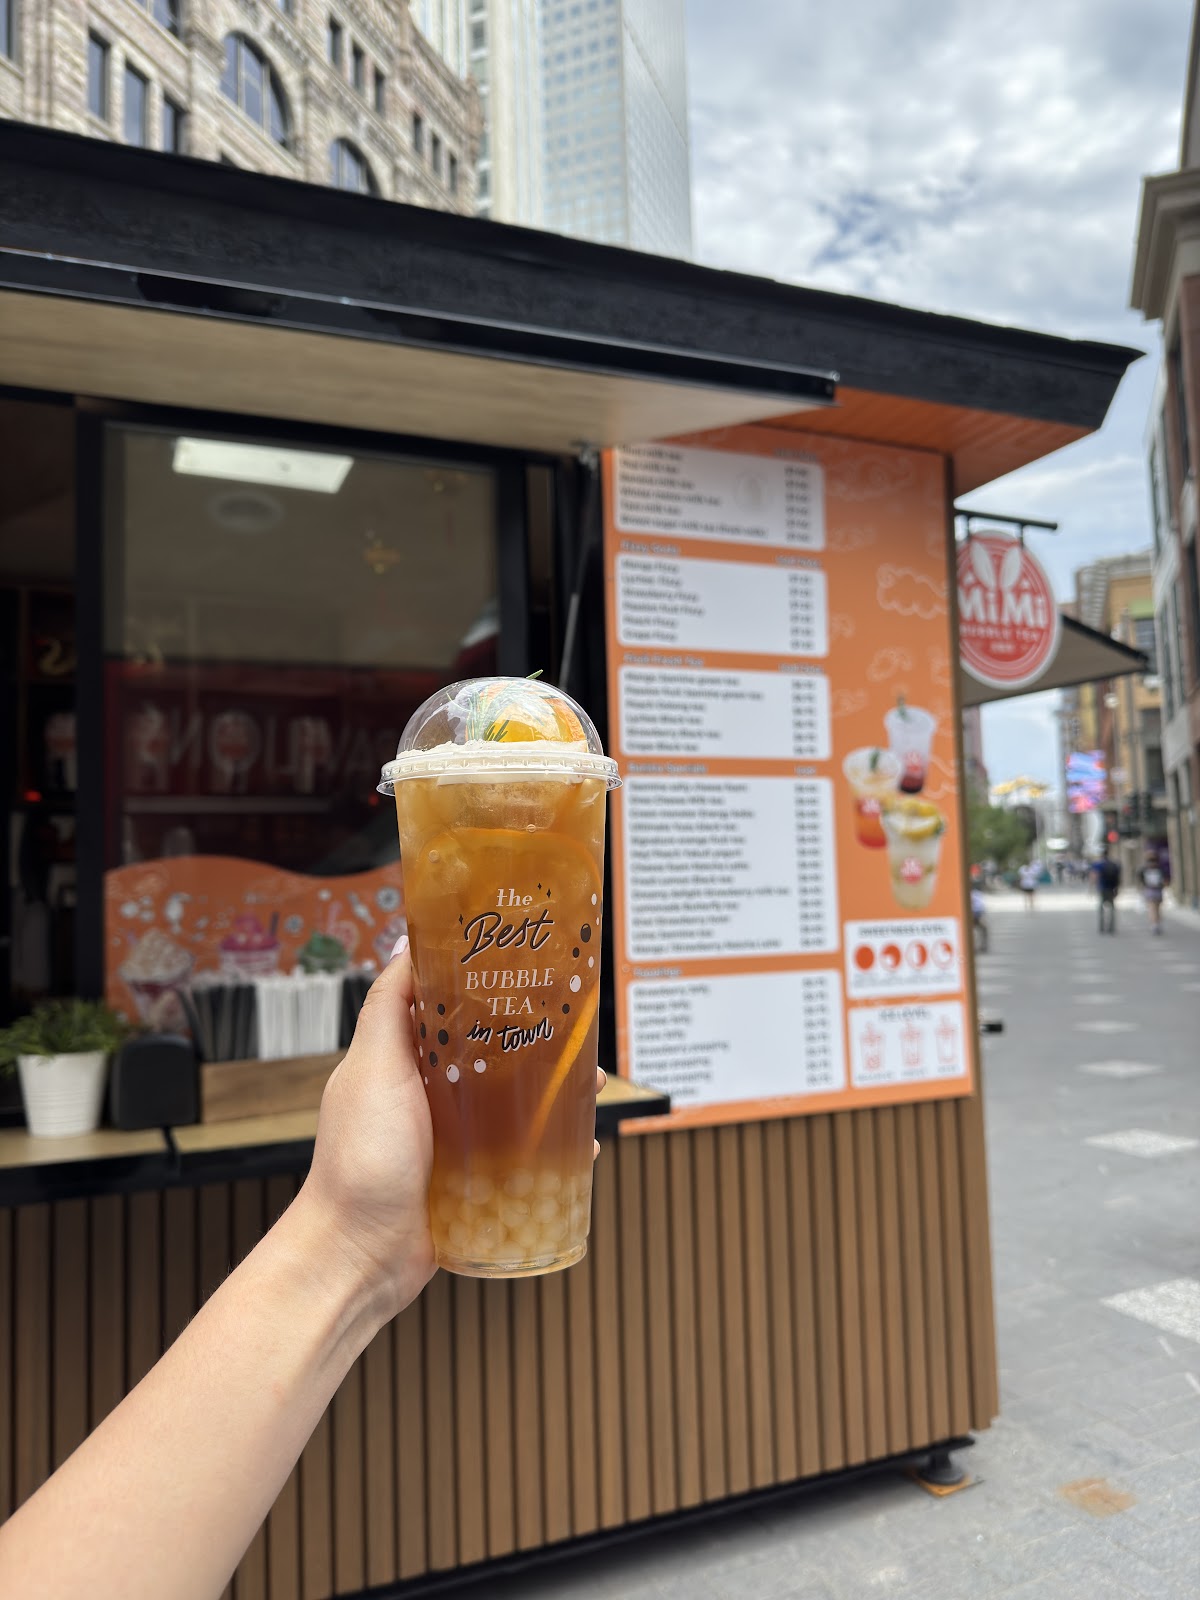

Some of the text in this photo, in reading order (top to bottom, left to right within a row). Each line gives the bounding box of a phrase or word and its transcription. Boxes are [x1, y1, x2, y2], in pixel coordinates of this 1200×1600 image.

[958, 586, 1047, 628] MiMi
[496, 888, 533, 907] the
[461, 909, 554, 964] Best
[465, 968, 555, 990] BUBBLE
[487, 995, 534, 1016] TEA
[466, 1016, 554, 1053] in town
